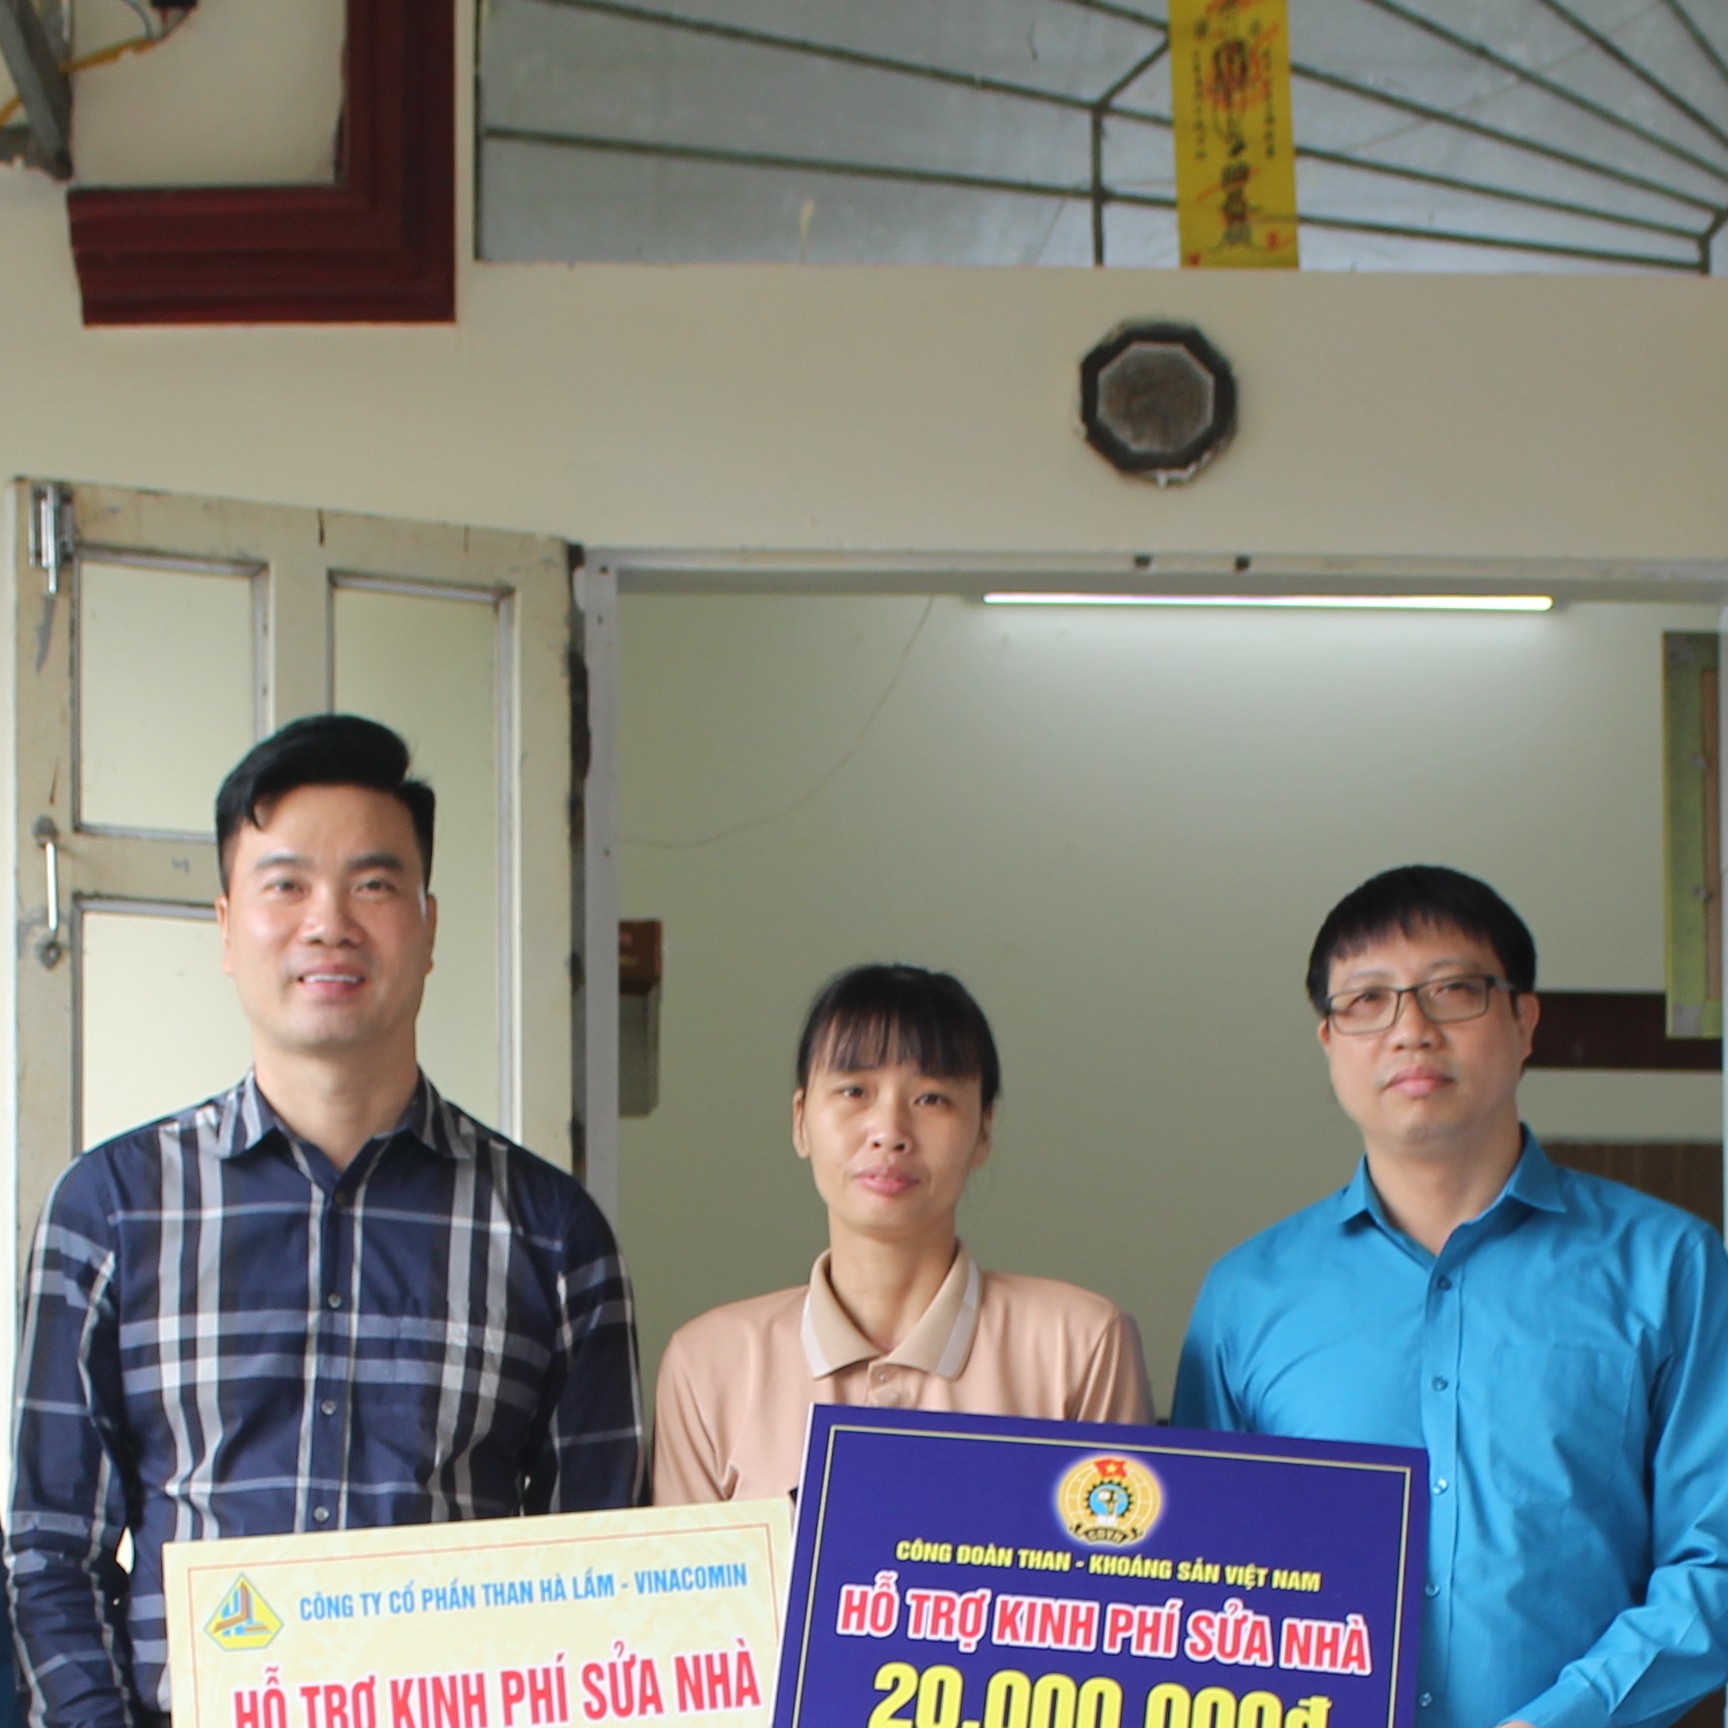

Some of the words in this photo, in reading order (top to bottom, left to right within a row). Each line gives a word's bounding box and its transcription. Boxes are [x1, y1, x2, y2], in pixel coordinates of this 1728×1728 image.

[299, 1592, 354, 1621] CÔNG
[360, 1592, 382, 1617] TY
[482, 1580, 533, 1606] THAN
[540, 1572, 567, 1602] HÀ
[634, 1562, 748, 1595] VINACOMIN
[896, 1538, 952, 1562] CÔNG
[956, 1543, 1013, 1568] ĐOÀN
[1018, 1548, 1072, 1572] THAN
[1089, 1553, 1173, 1580] KHOÁNG
[1177, 1556, 1221, 1584] SẢN
[1225, 1562, 1269, 1591] VIỆT
[1272, 1569, 1323, 1593] NAM
[837, 1571, 899, 1638] HỖ
[907, 1588, 988, 1653] TRỢ
[993, 1597, 1096, 1652] KINH
[1105, 1599, 1183, 1659] PHÍ
[1186, 1600, 1270, 1665] SỬA
[1281, 1613, 1372, 1674] NHÀ
[503, 1652, 569, 1726] PHÍ
[584, 1640, 662, 1721] SỬA
[676, 1638, 762, 1713] NHÀ
